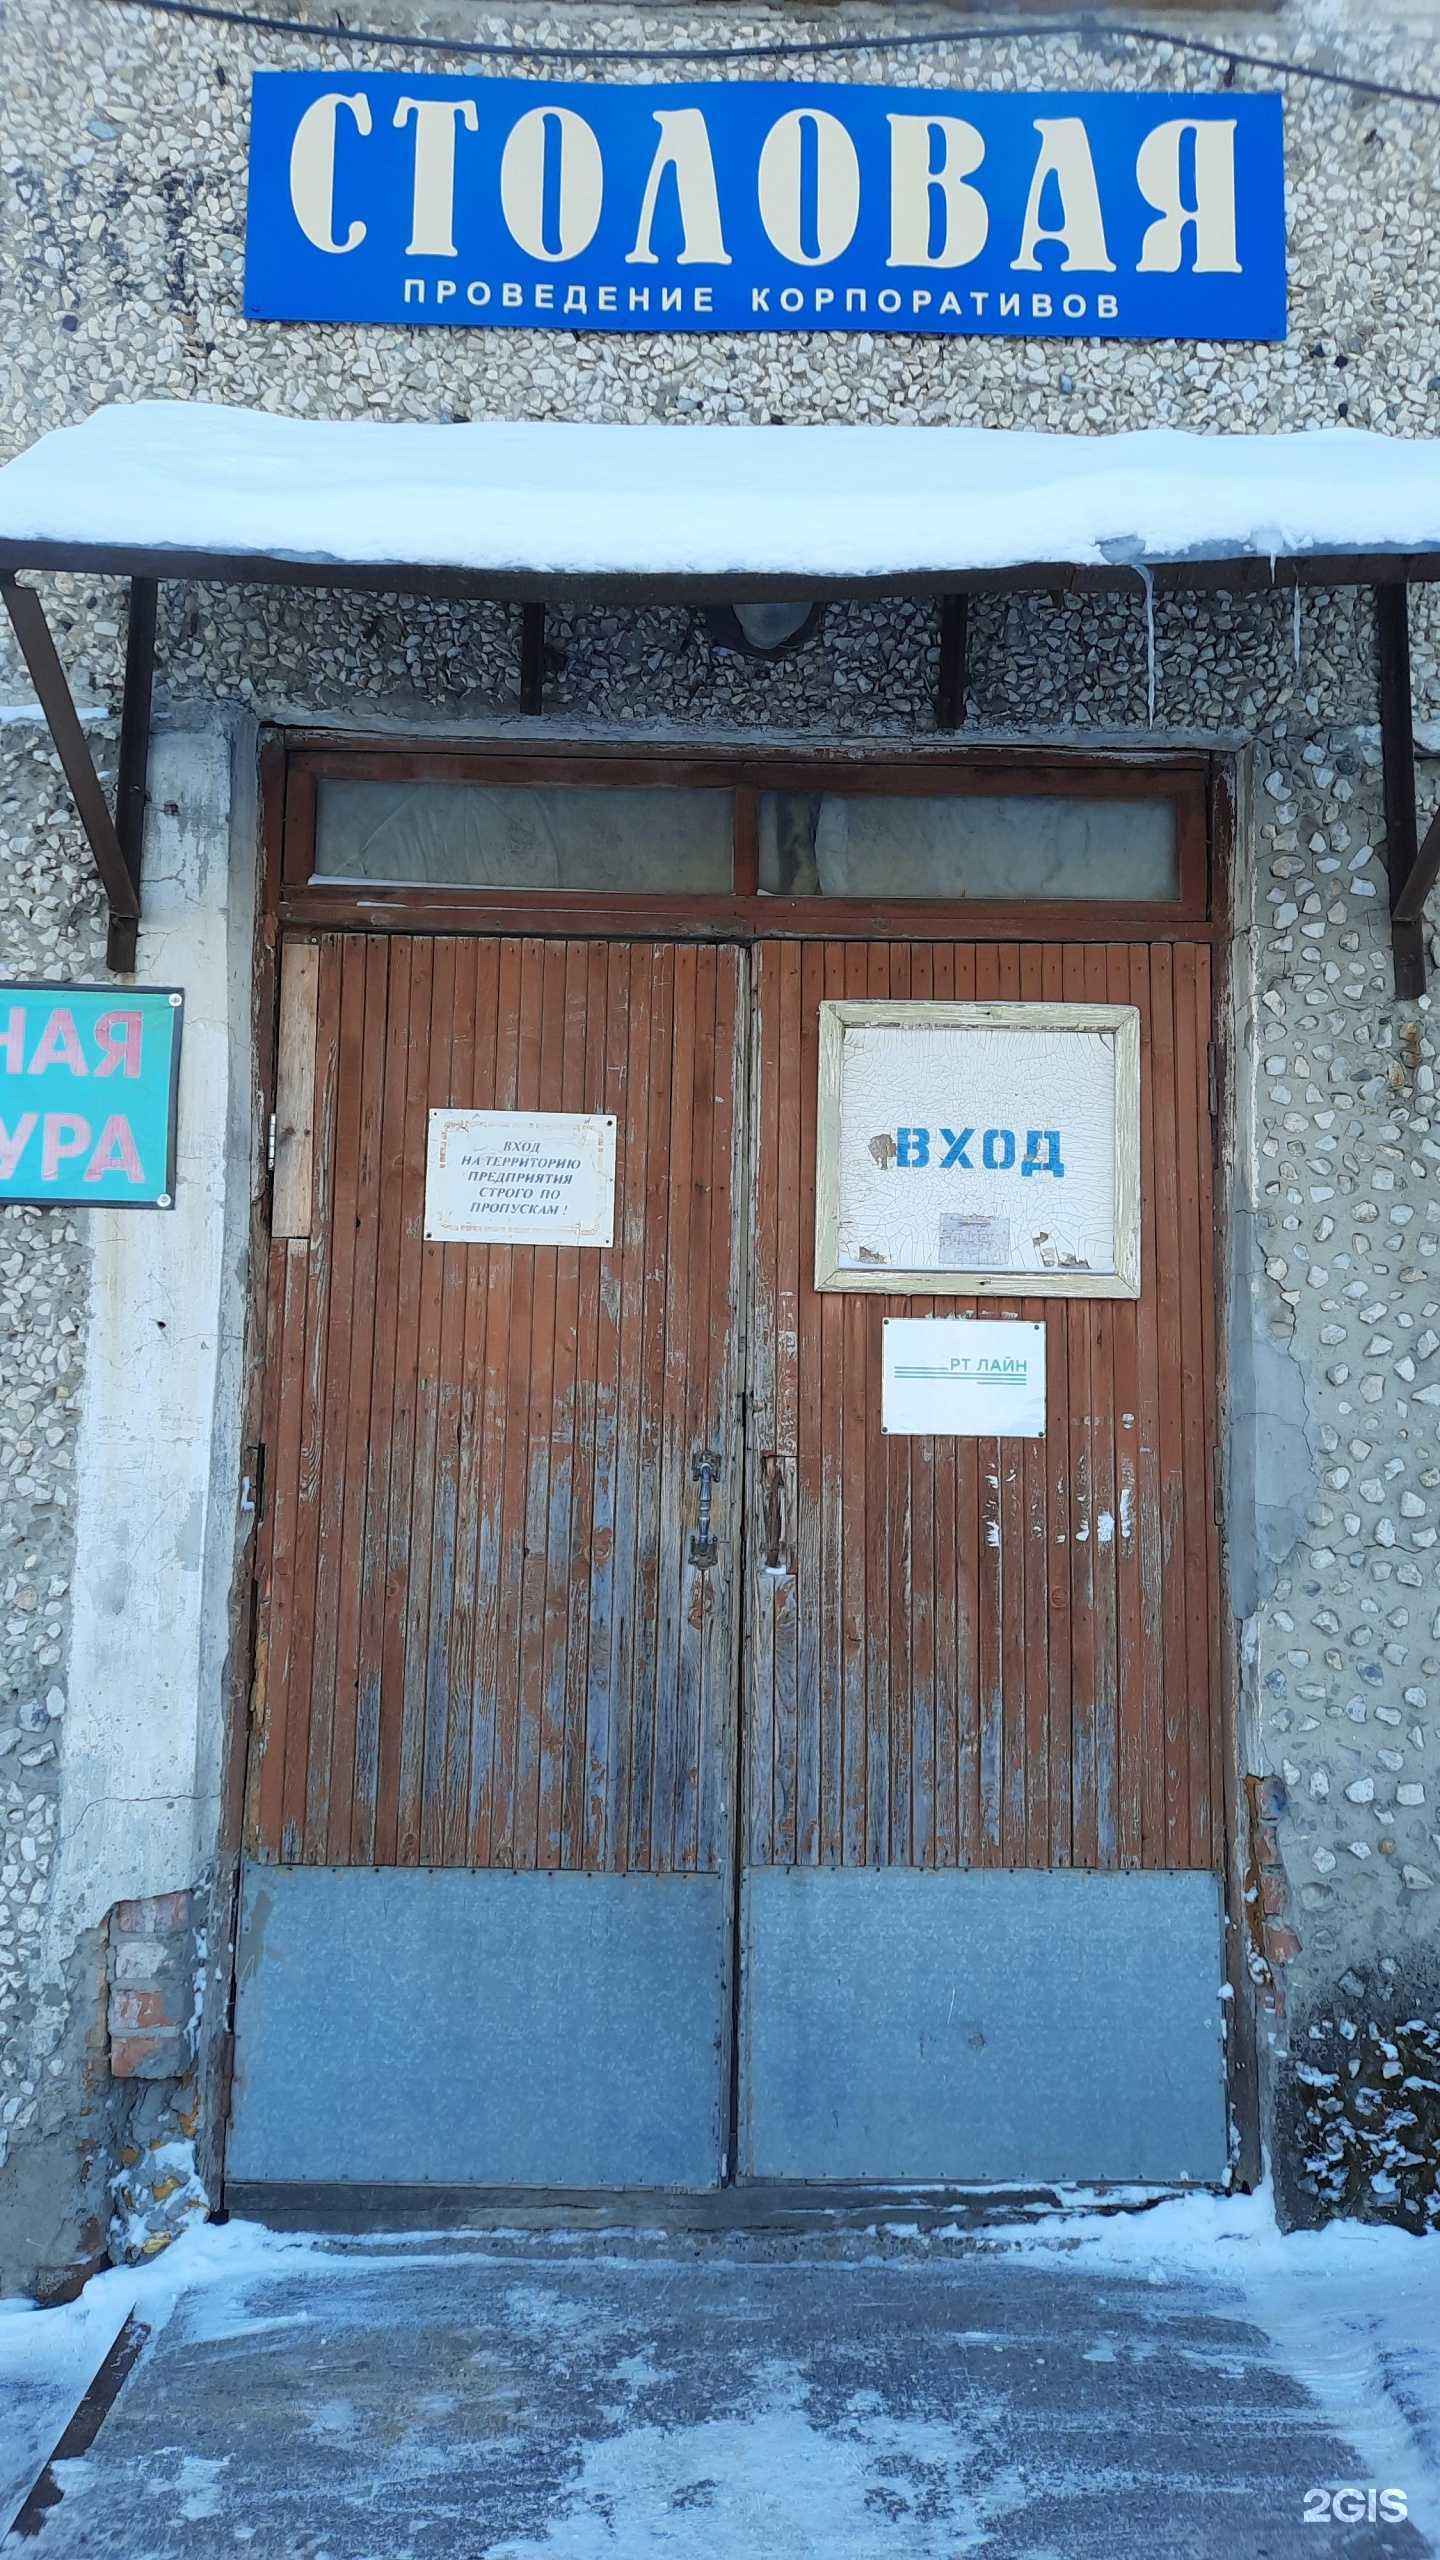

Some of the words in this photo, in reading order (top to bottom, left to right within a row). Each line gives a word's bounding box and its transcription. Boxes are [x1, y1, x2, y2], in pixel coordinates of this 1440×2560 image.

[290, 92, 1242, 274] СТОЛОВАЯ
[404, 277, 716, 315] ПРОВЕДЕНИЕ
[751, 286, 1121, 320] КОРПОРАТИВОВ
[503, 1140, 542, 1155] ВХОД
[896, 1127, 1065, 1178] ВХОД
[461, 1155, 481, 1167] НА
[485, 1156, 581, 1170] ТЕРРИТОРИЮ
[468, 1171, 574, 1186] ПРЕДПРИЯТИЯ
[479, 1187, 534, 1200] СТРОГО
[540, 1188, 561, 1201] ПО
[977, 1356, 1028, 1373] ЛАЙН
